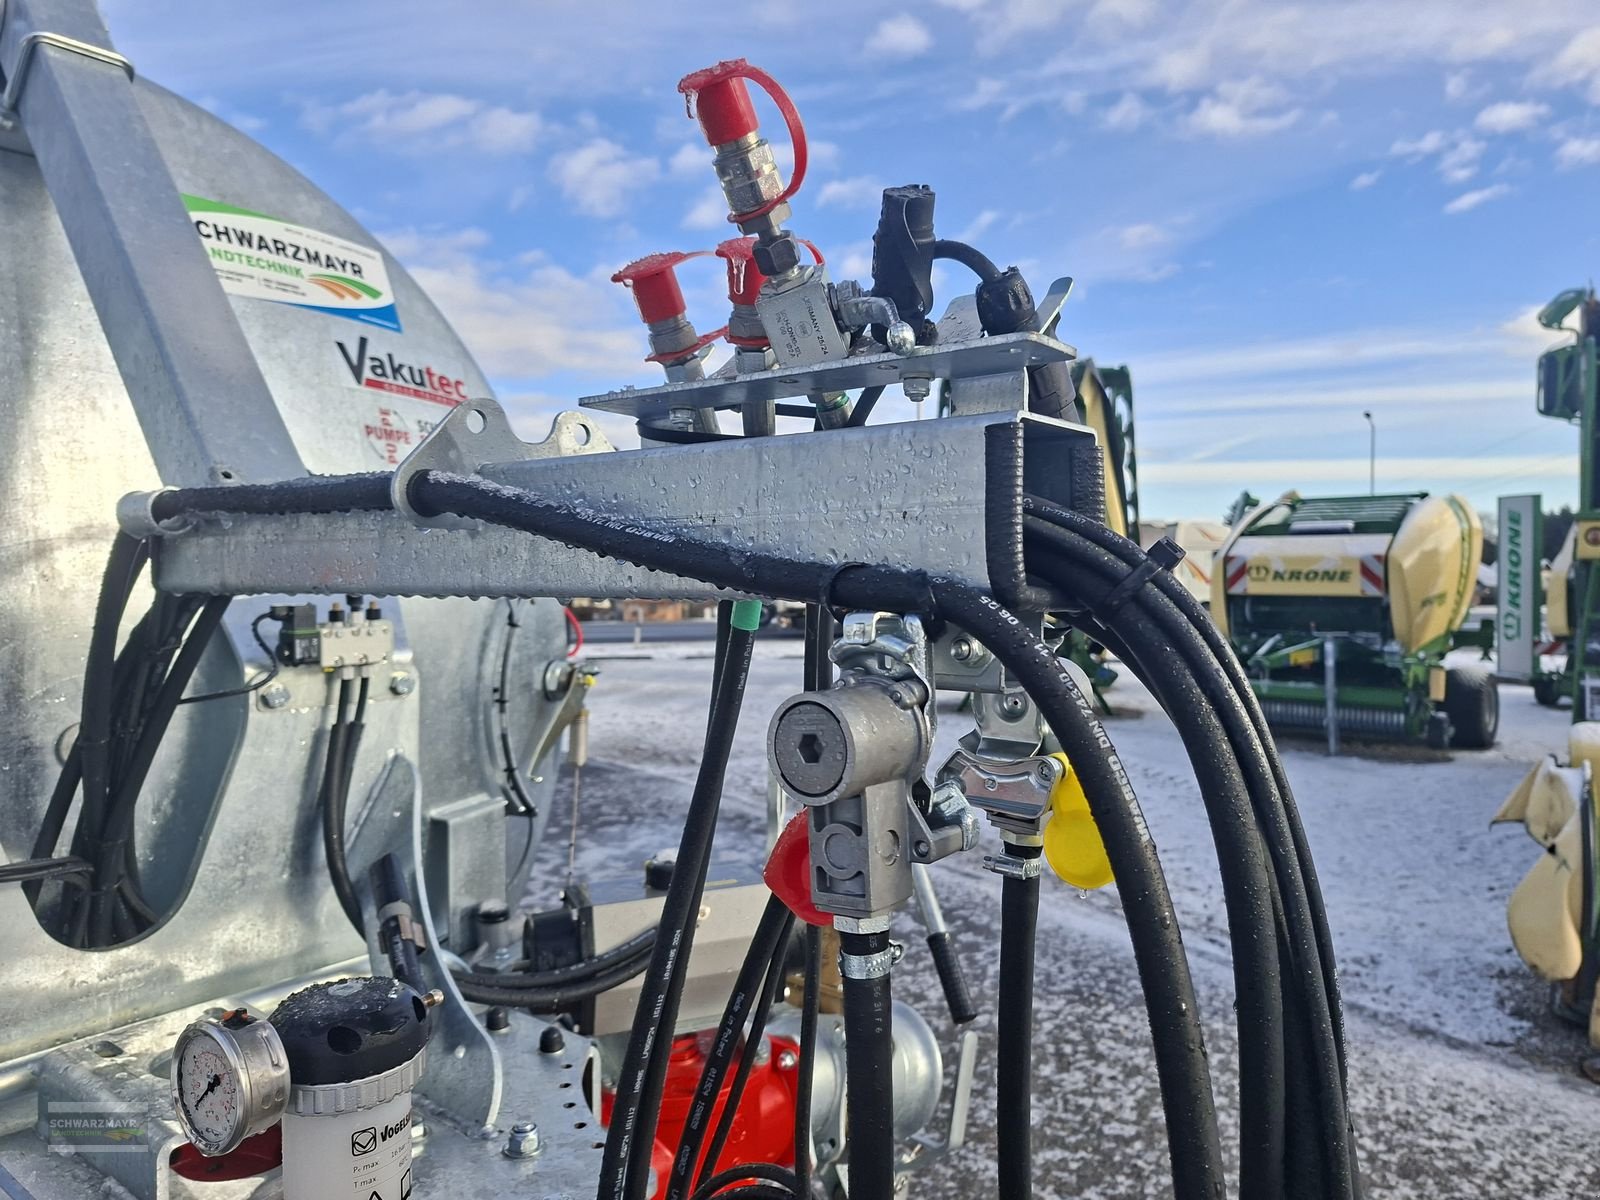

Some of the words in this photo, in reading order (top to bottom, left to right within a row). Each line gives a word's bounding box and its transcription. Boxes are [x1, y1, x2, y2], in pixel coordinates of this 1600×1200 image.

[335, 336, 468, 399] Vakutec
[365, 424, 411, 444] PUMPE
[1508, 510, 1521, 609] KRONE
[1272, 570, 1352, 582] KRONE
[1089, 719, 1111, 749] DIN
[363, 1161, 379, 1171] max
[360, 1177, 377, 1187] max
